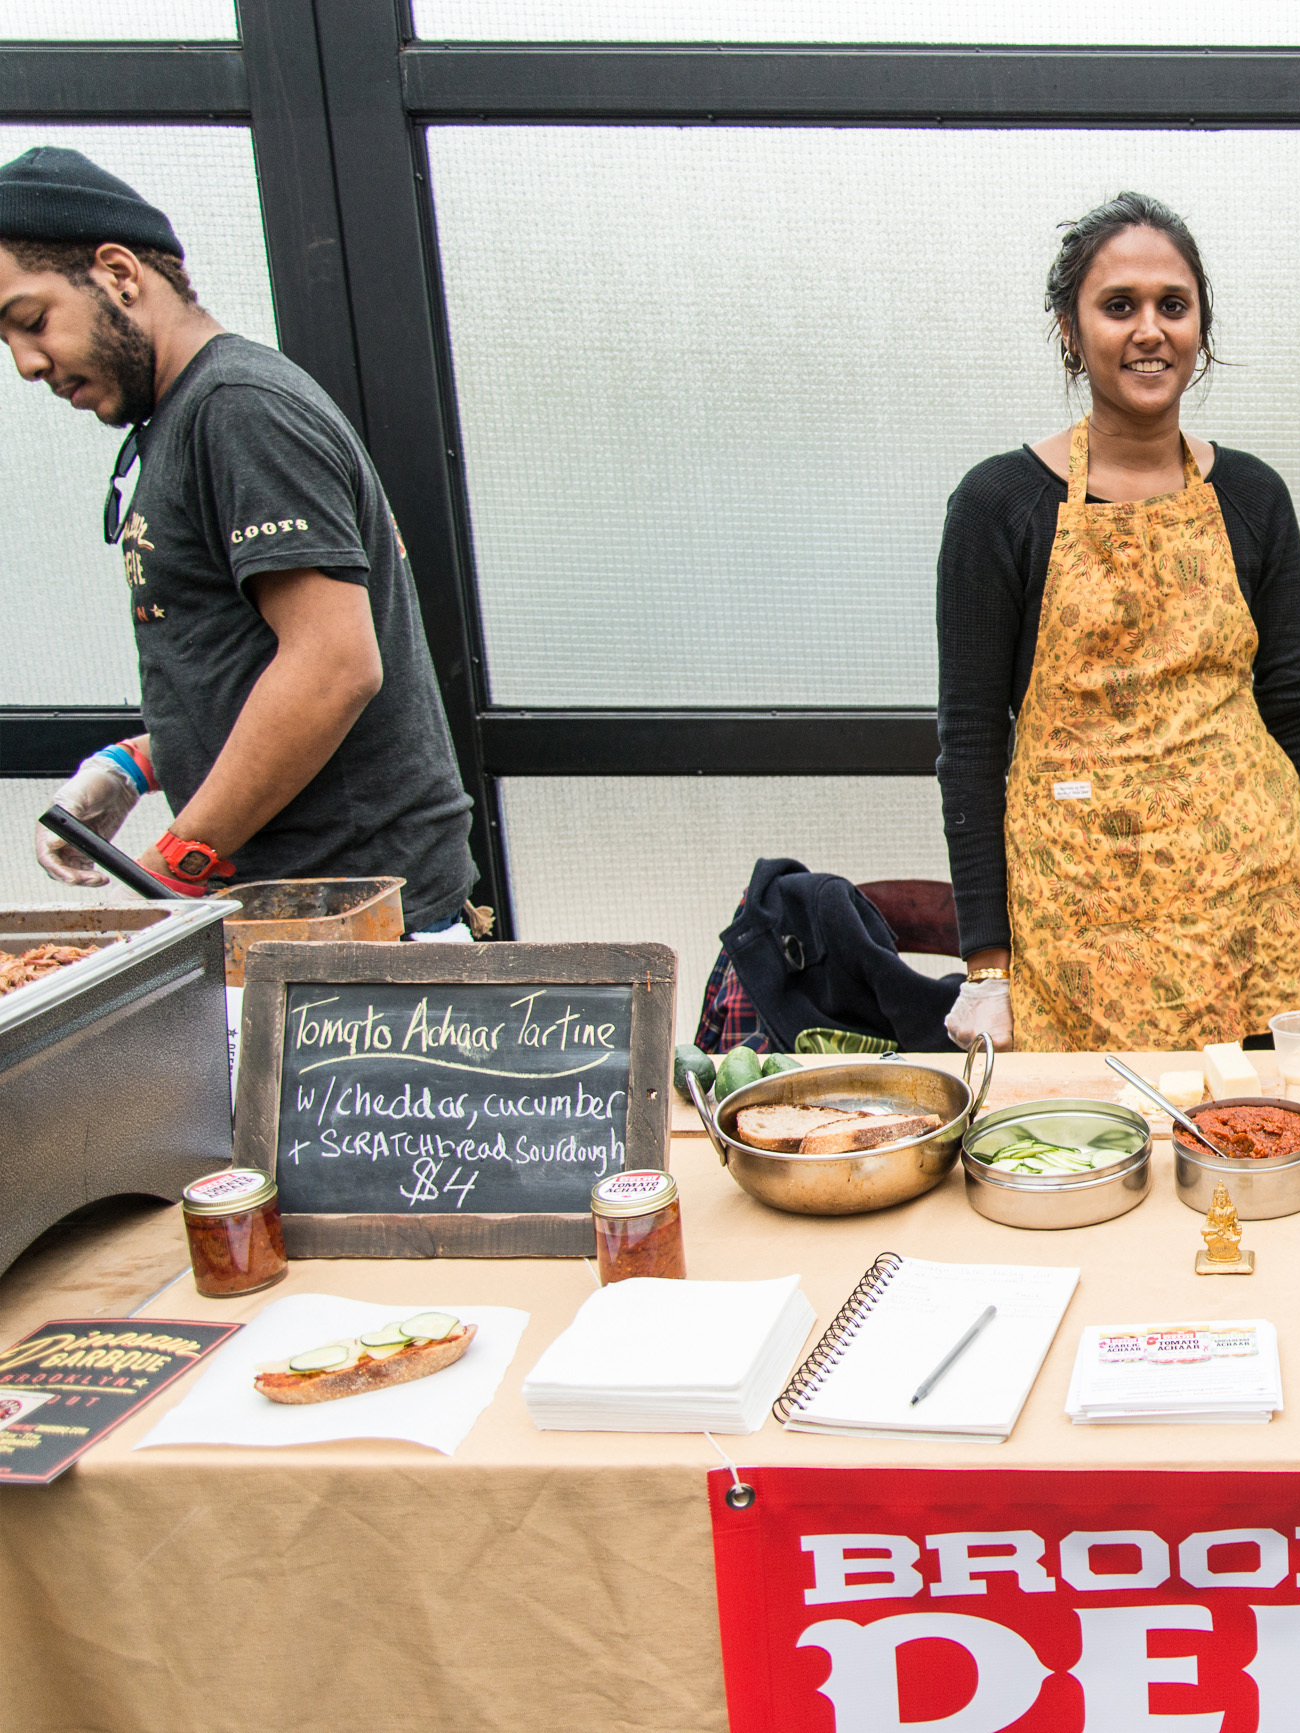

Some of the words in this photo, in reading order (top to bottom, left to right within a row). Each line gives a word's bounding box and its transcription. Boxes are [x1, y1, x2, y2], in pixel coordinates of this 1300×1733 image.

[231, 518, 309, 543] COOTS
[291, 996, 392, 1055] Tomato
[402, 997, 505, 1052] Achaar
[510, 989, 616, 1051] Tartine
[400, 1156, 480, 1209] $4
[1159, 1339, 1199, 1347] TOMATO
[0, 1373, 131, 1387] BROOKLYN
